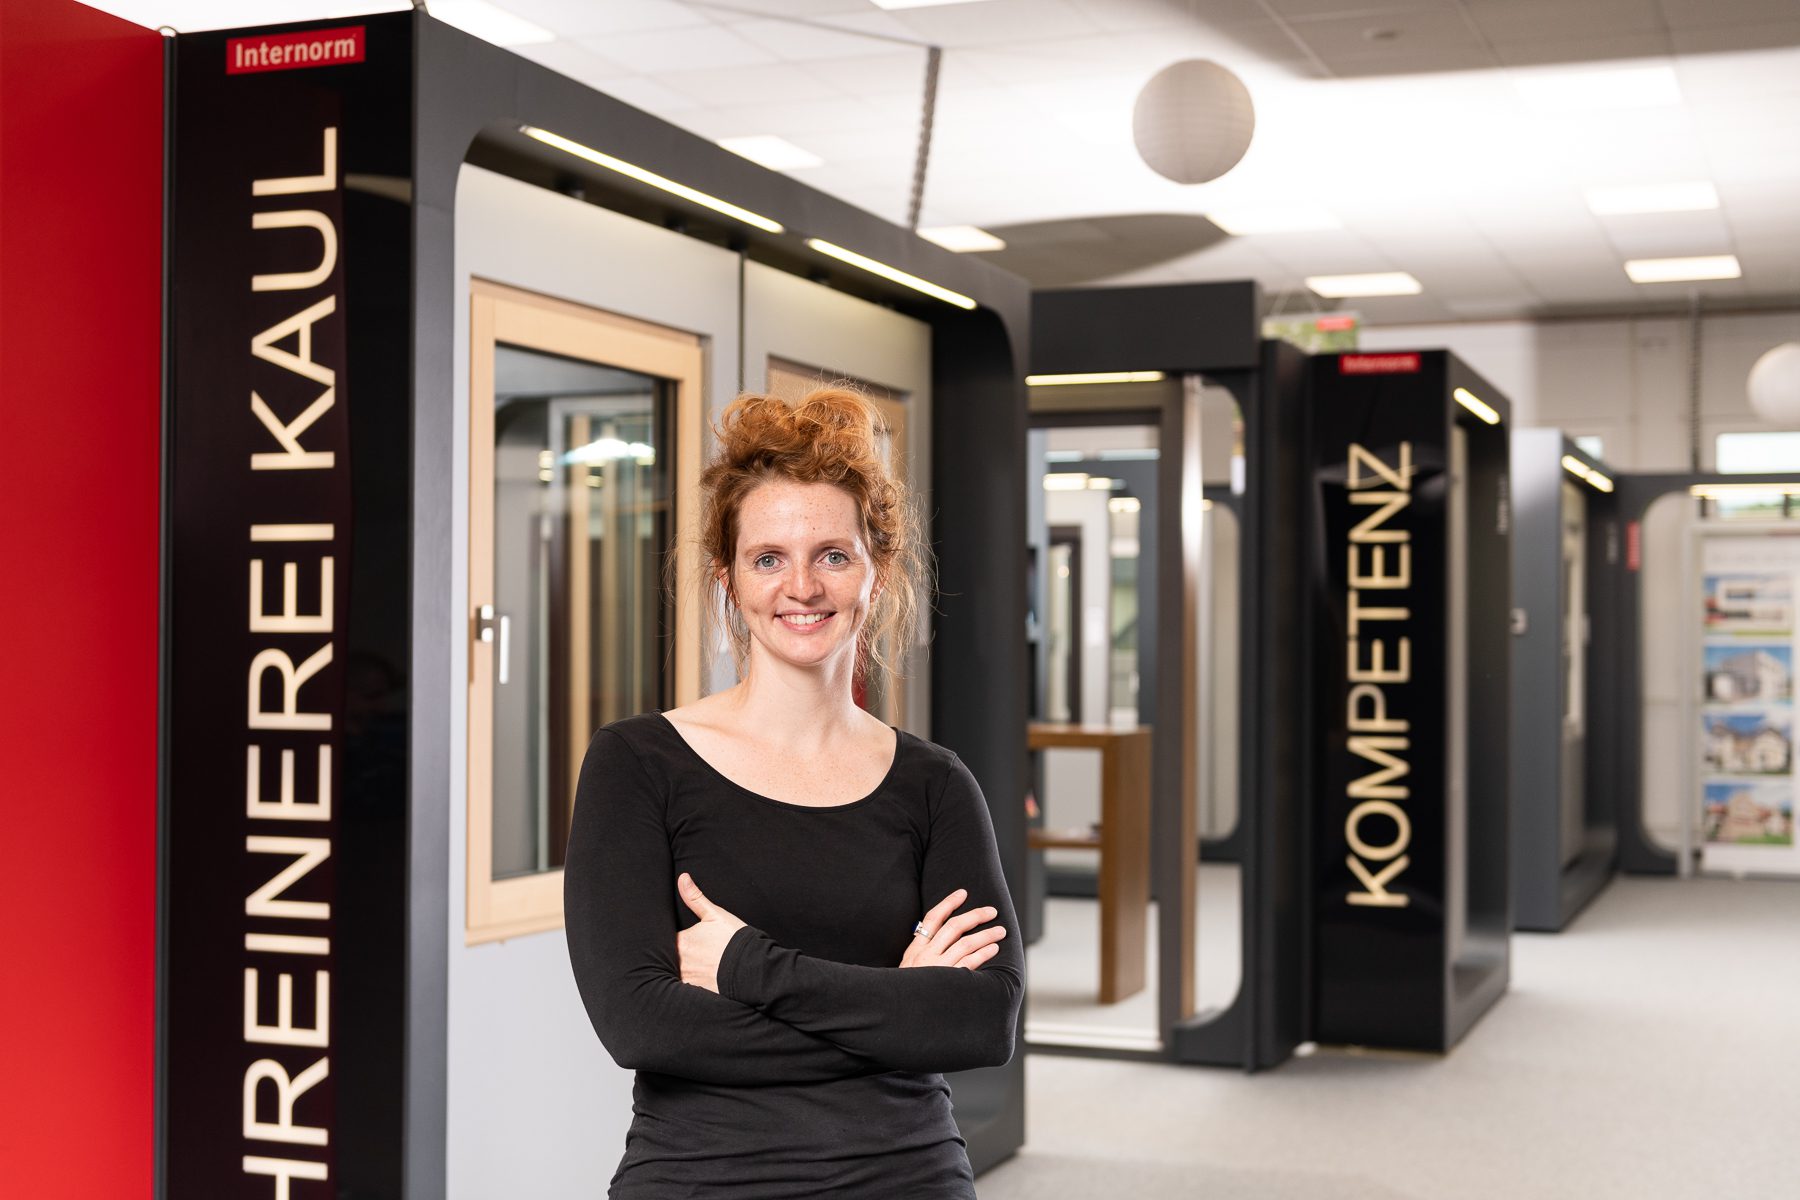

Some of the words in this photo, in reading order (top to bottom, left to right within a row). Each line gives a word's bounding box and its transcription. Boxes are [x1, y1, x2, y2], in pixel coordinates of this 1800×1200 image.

[235, 39, 356, 68] Internorm
[250, 127, 338, 470] KAUL
[1346, 441, 1412, 907] KOMPETENZ
